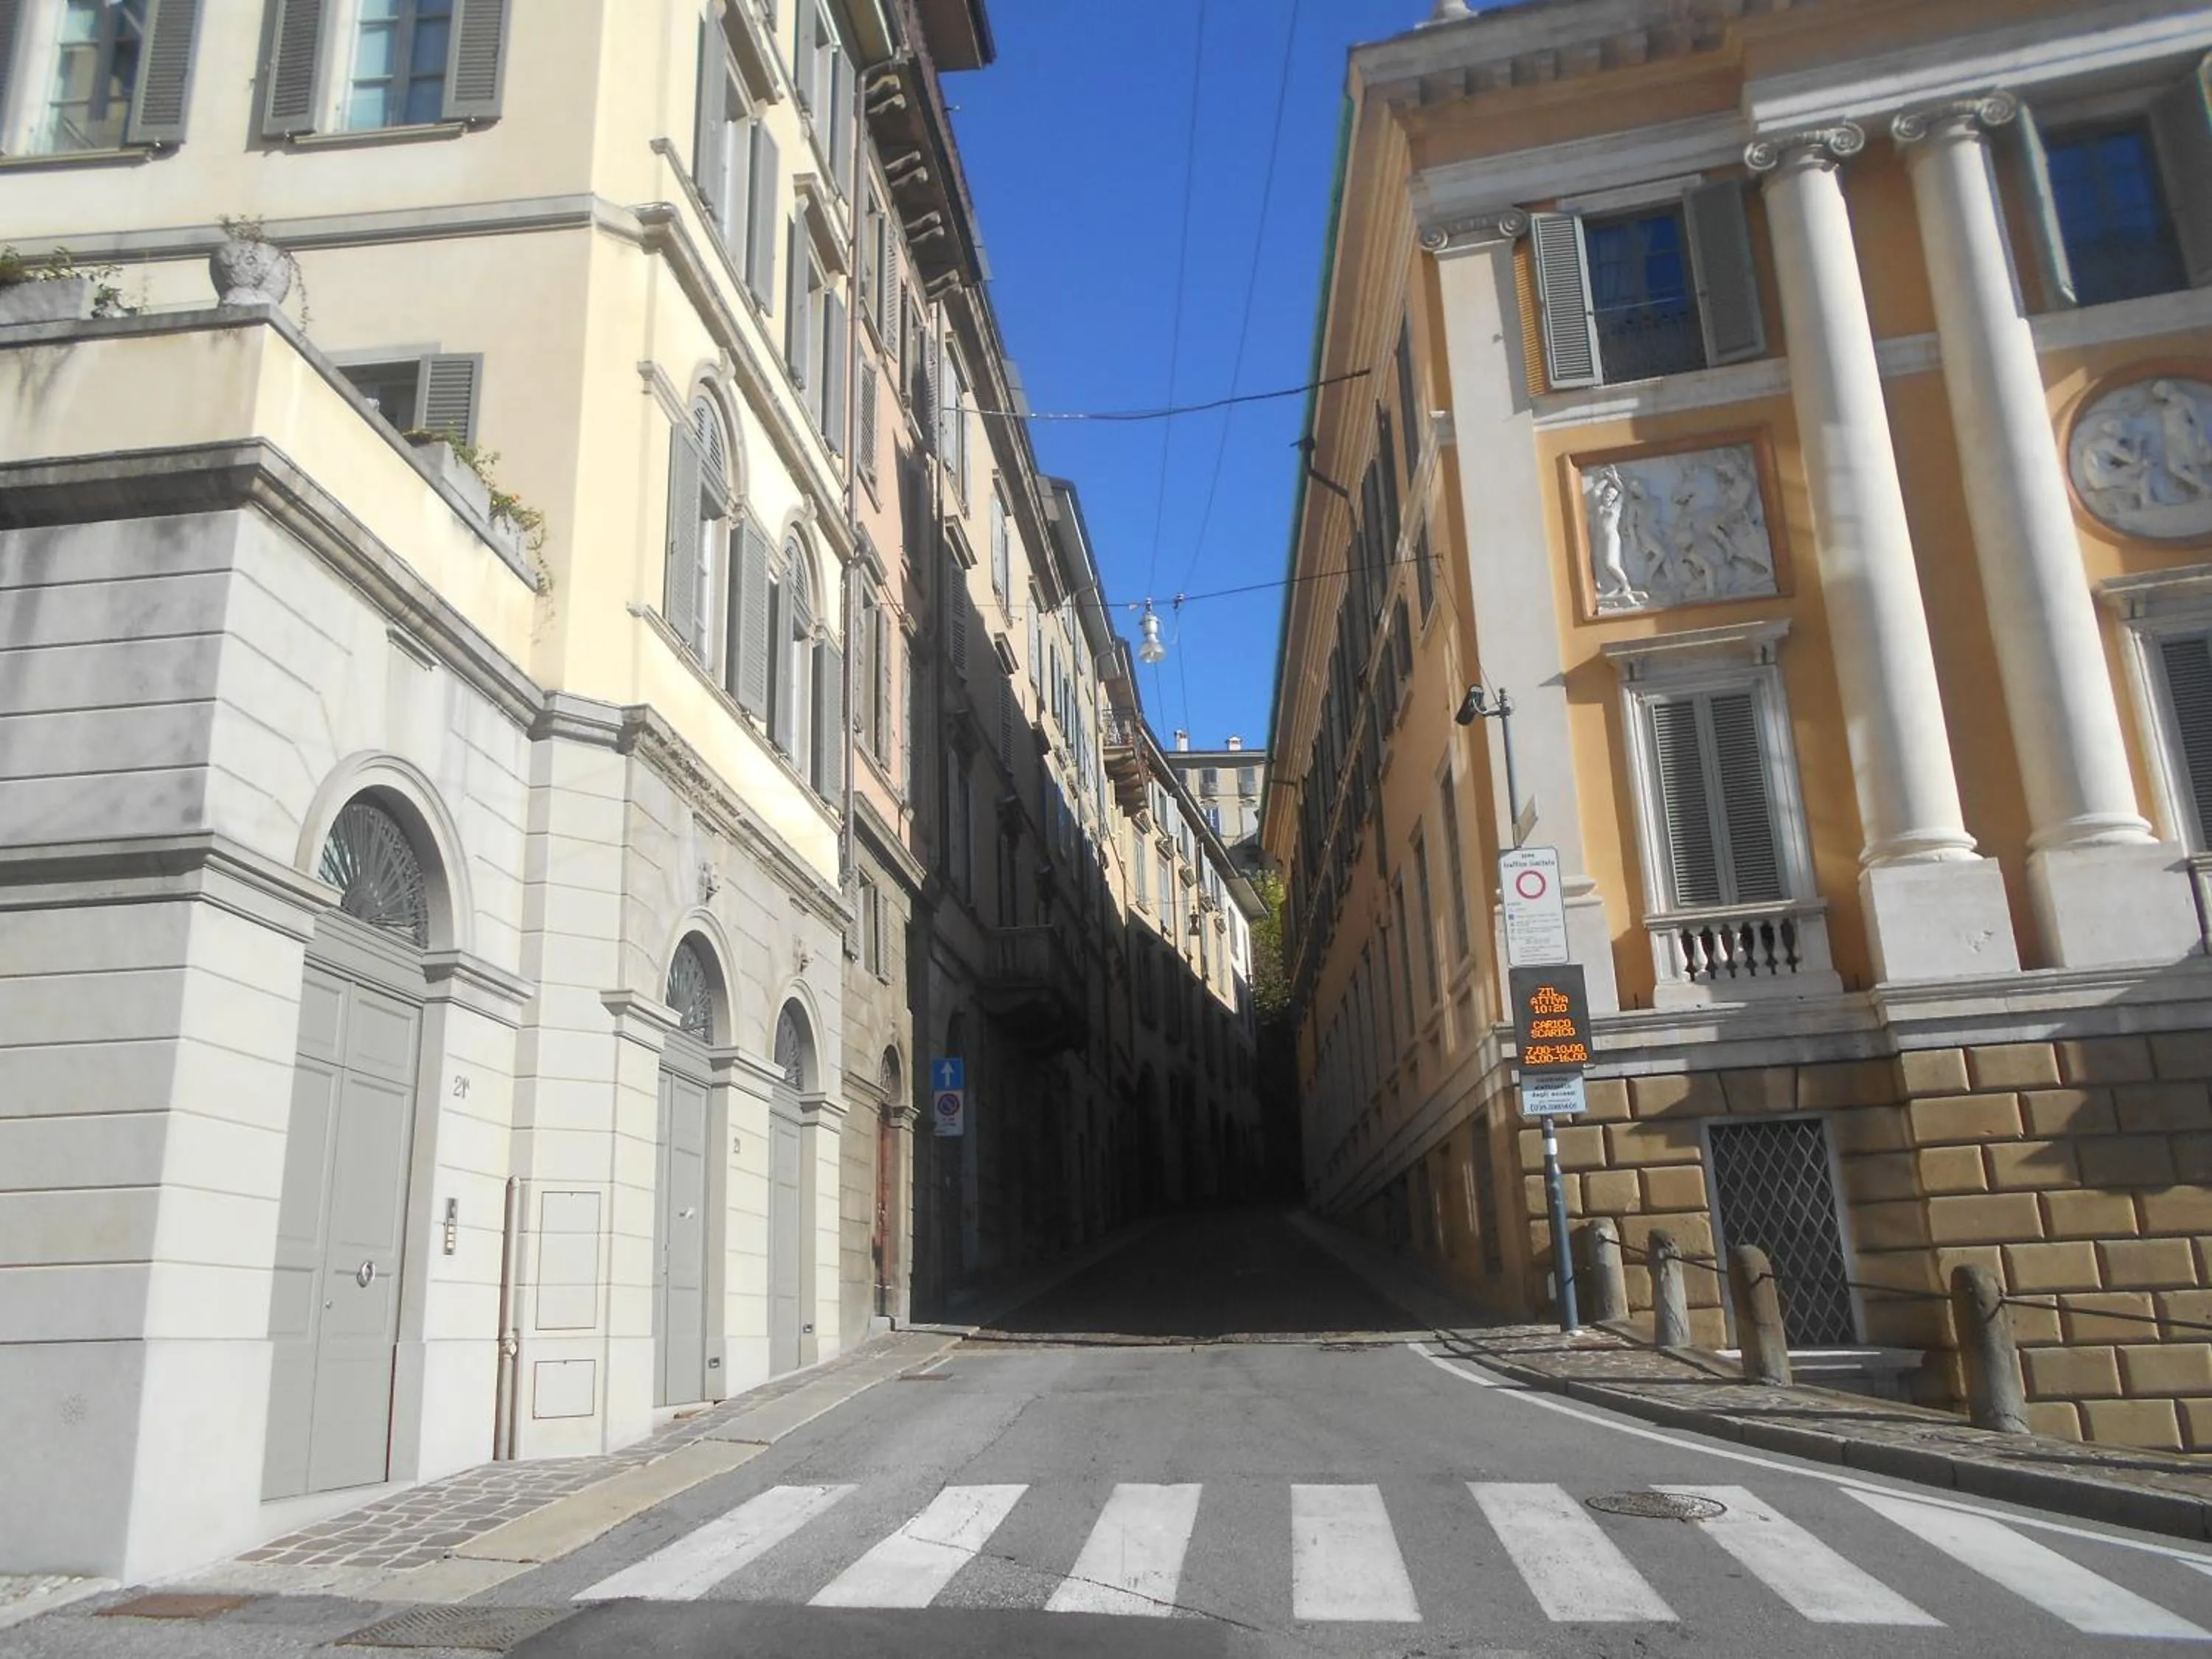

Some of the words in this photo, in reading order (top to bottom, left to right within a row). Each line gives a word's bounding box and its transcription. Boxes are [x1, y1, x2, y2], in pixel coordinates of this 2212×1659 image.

[1537, 987, 1558, 996] ZTL
[1530, 995, 1568, 1006] ATTIVA
[1534, 1004, 1568, 1014] 10:20
[1533, 1019, 1571, 1029] CARICO
[1531, 1027, 1576, 1038] SCARICO
